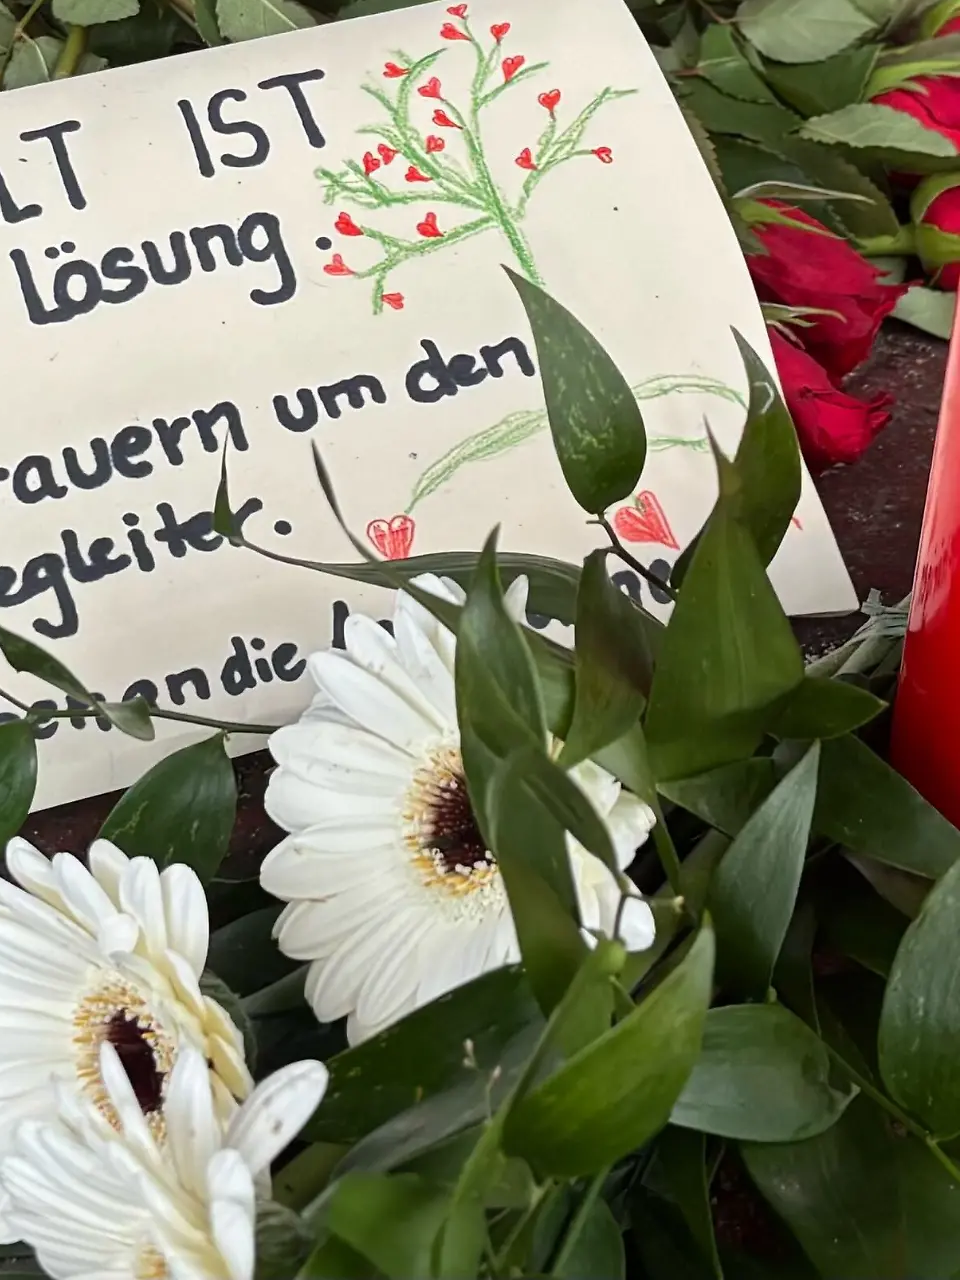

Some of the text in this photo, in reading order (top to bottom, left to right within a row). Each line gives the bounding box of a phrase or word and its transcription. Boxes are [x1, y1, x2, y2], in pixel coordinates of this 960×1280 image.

[176, 69, 327, 178] IST
[273, 374, 386, 433] um
[405, 335, 537, 404] den
[220, 636, 306, 696] die
